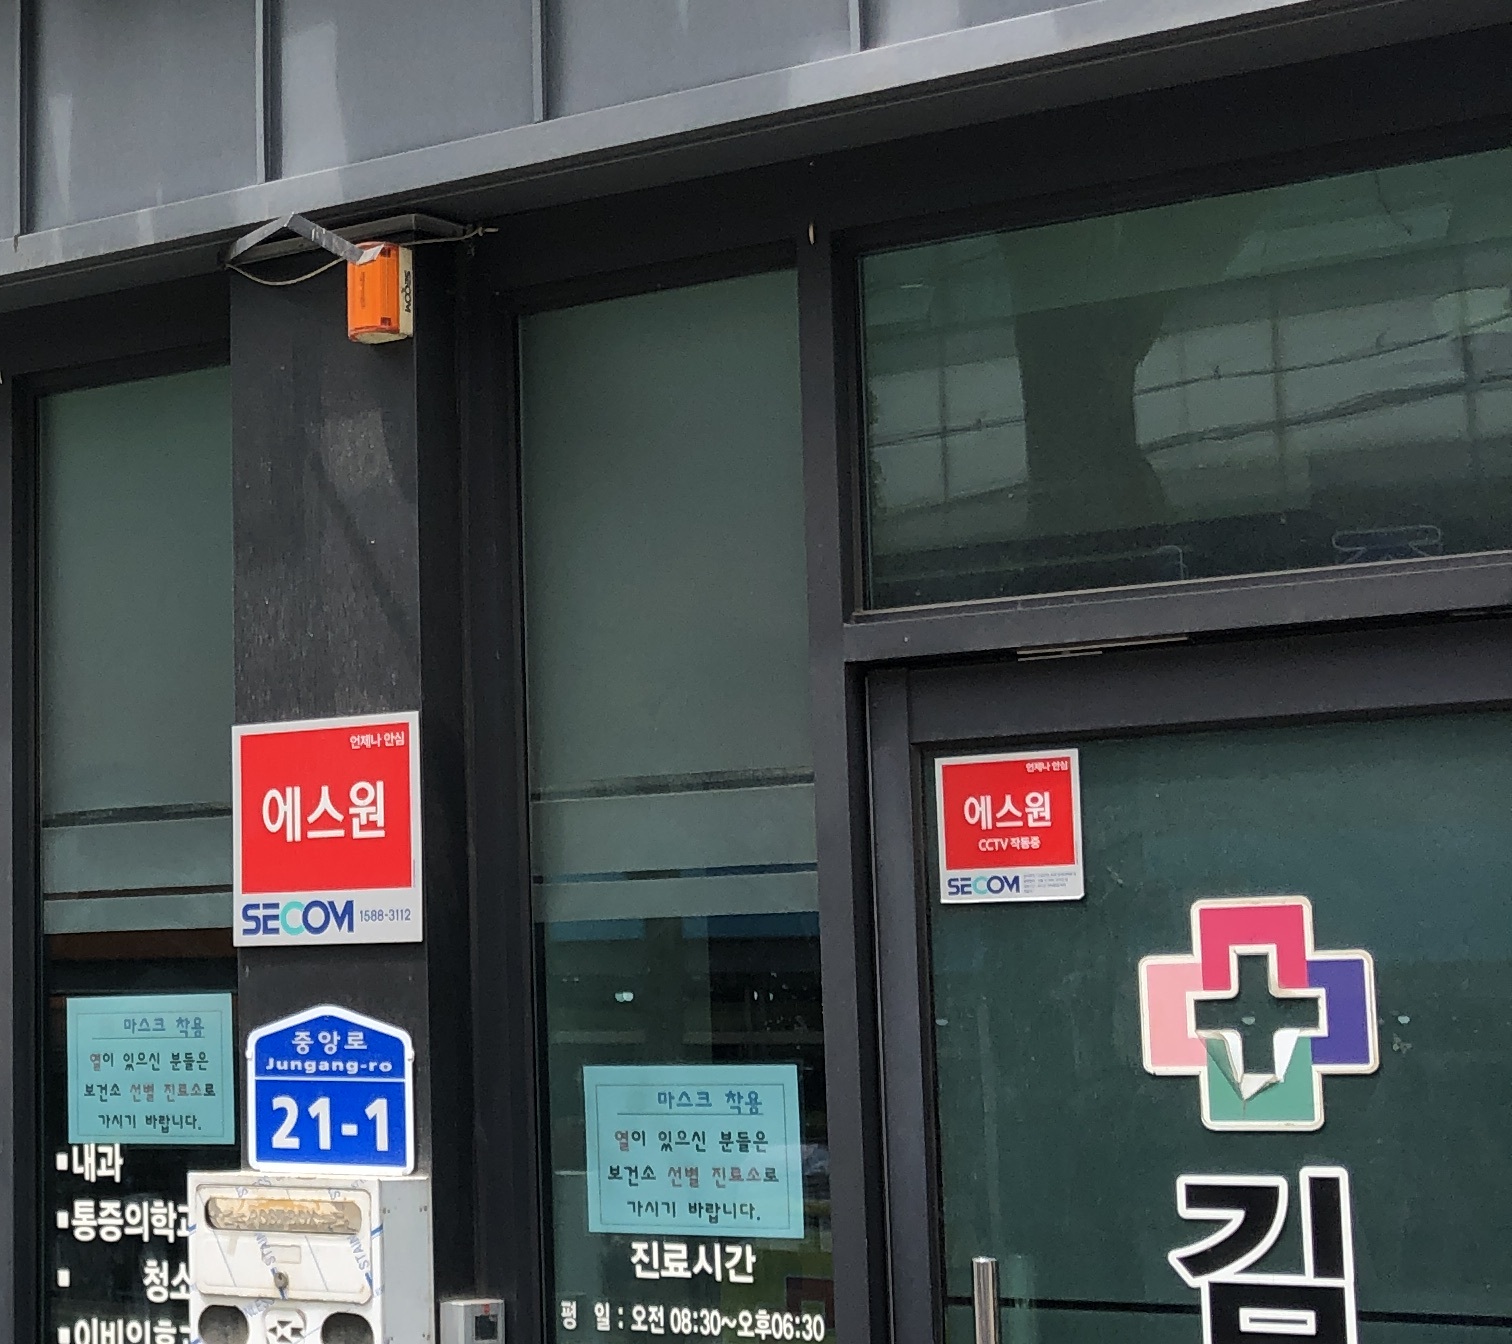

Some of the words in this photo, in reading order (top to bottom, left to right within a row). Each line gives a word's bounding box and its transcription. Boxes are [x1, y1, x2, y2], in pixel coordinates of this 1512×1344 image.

[350, 733, 382, 749] 언제나
[384, 731, 405, 747] 안심
[262, 780, 386, 843] 에스원
[963, 791, 1052, 830] 에스원
[978, 838, 1009, 852] CCTV
[1010, 836, 1041, 850] 작동중
[947, 875, 1021, 896] SECOM
[242, 899, 355, 936] SECOM
[359, 909, 411, 923] 1588-3112
[123, 1017, 166, 1034] 마스크
[175, 1016, 205, 1038] 착용
[291, 1030, 368, 1055] 중앙로
[89, 1052, 114, 1072] 열이
[123, 1052, 161, 1072] 있으신
[169, 1051, 209, 1072] 분들은
[265, 1057, 393, 1075] Jungang-ro
[84, 1083, 121, 1103] 보건소
[129, 1083, 155, 1103] 선별
[163, 1083, 216, 1103] 진료소로
[657, 1090, 712, 1109] 마스크
[724, 1090, 763, 1115] 착용
[98, 1114, 136, 1129] 가시기
[145, 1114, 202, 1134] 바랍니다.
[271, 1096, 389, 1152] 21-1
[614, 1130, 646, 1152] 열이
[657, 1130, 707, 1153] 있으신
[718, 1130, 769, 1153] 분들은
[71, 1142, 124, 1183] 내과
[607, 1165, 657, 1187] 보건소
[667, 1165, 700, 1188] 선별
[711, 1166, 780, 1188] 진료소로
[627, 1201, 676, 1218] 가시기
[688, 1202, 761, 1224] 바랍니다.
[629, 1240, 757, 1284] 진료시간
[630, 1303, 665, 1335] 오전
